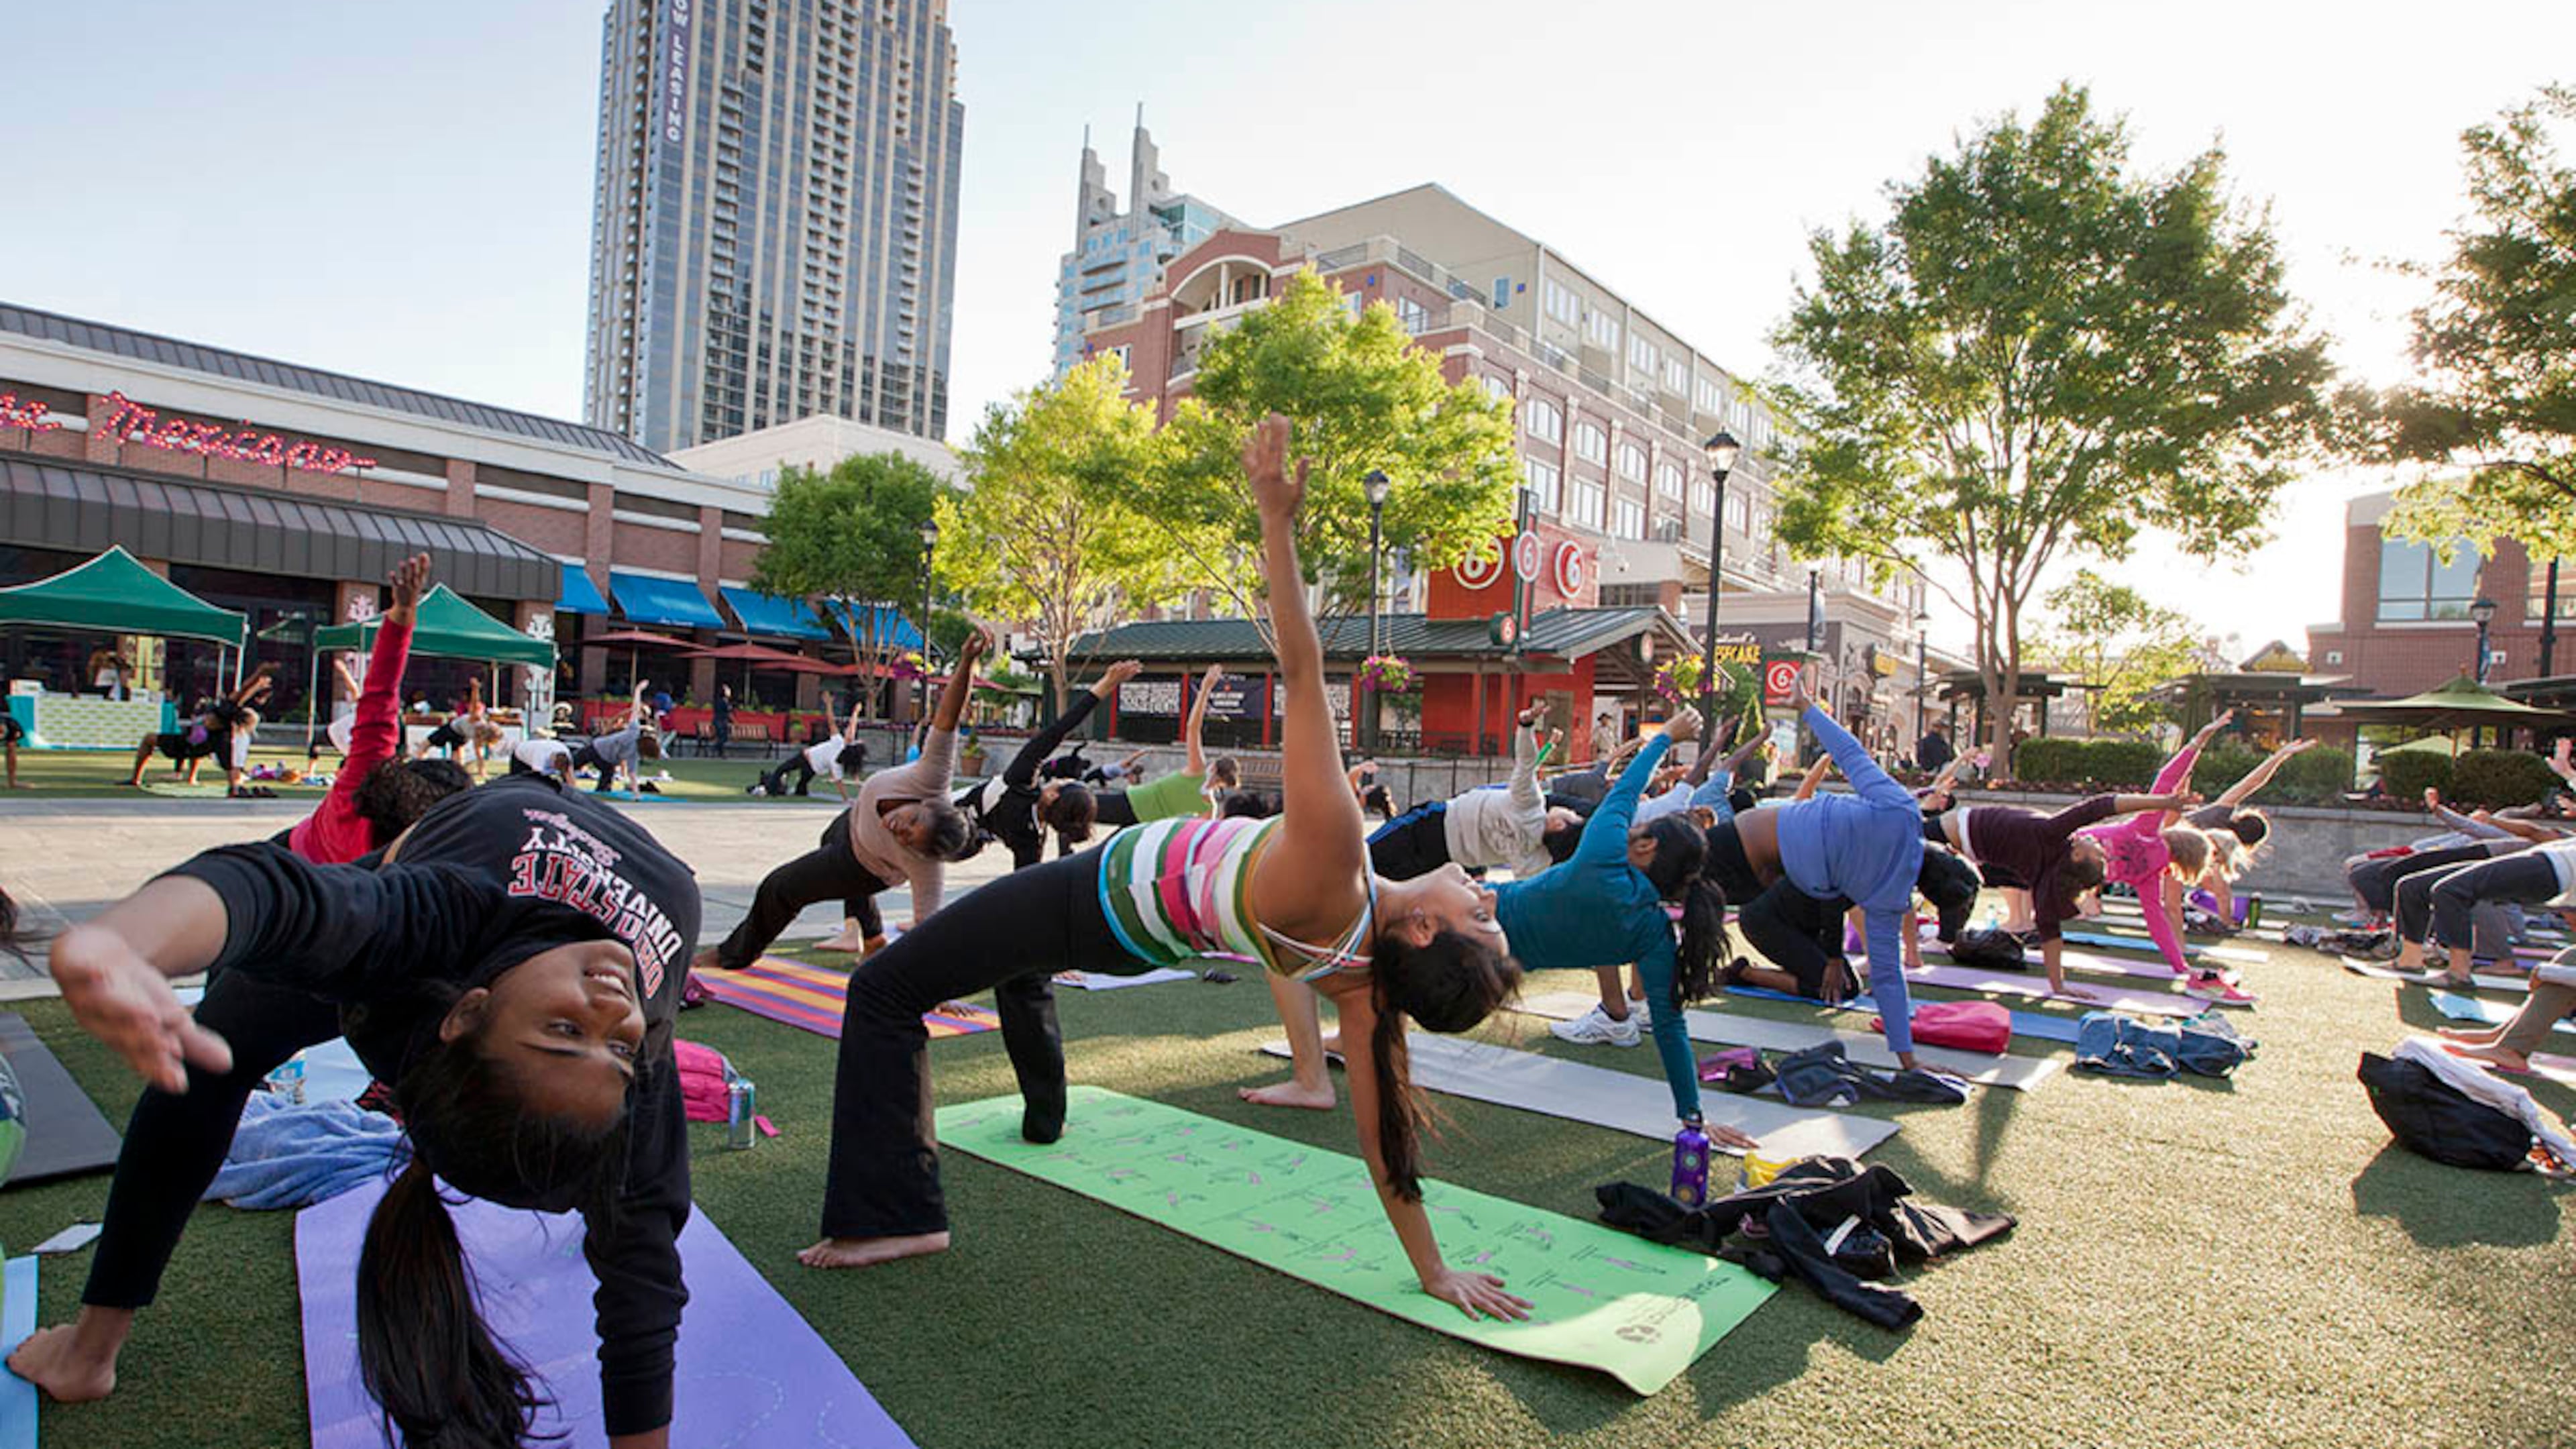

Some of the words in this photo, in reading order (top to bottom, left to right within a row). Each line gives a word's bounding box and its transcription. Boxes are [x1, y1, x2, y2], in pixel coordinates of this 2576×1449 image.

[672, 0, 689, 27] OW
[667, 34, 684, 142] LEASING
[95, 390, 376, 472] Mexicano
[1566, 550, 1581, 588] 6
[508, 853, 623, 925] STATE
